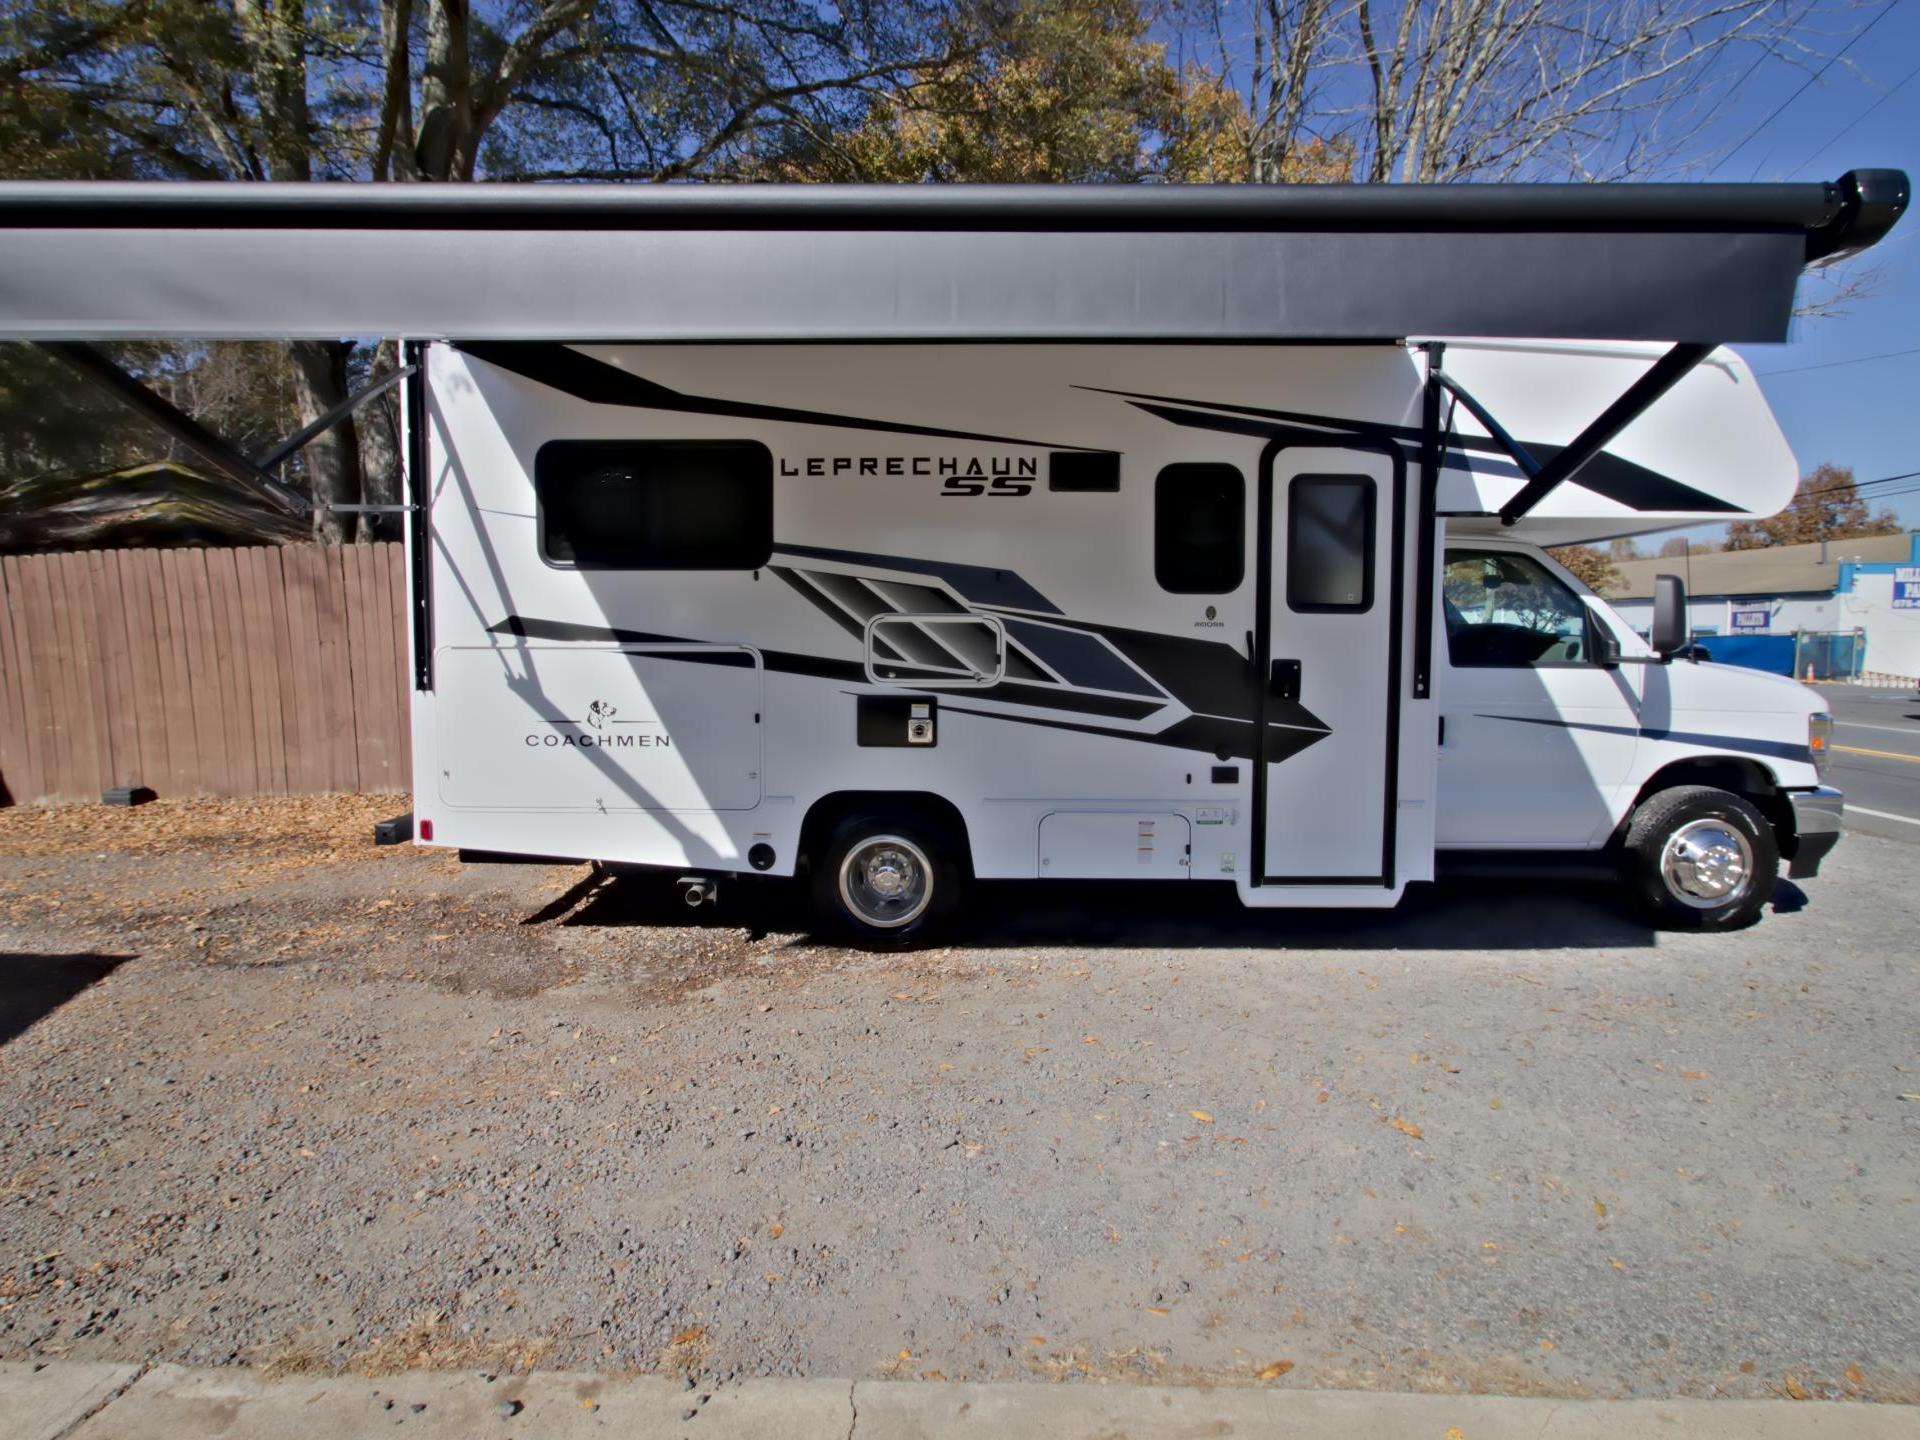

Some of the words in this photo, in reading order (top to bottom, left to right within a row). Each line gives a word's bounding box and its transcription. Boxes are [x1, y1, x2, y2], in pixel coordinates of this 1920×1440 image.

[780, 457, 1037, 476] LEPRECHAUN
[941, 476, 1036, 497] SS
[525, 734, 670, 748] COACHMEN
